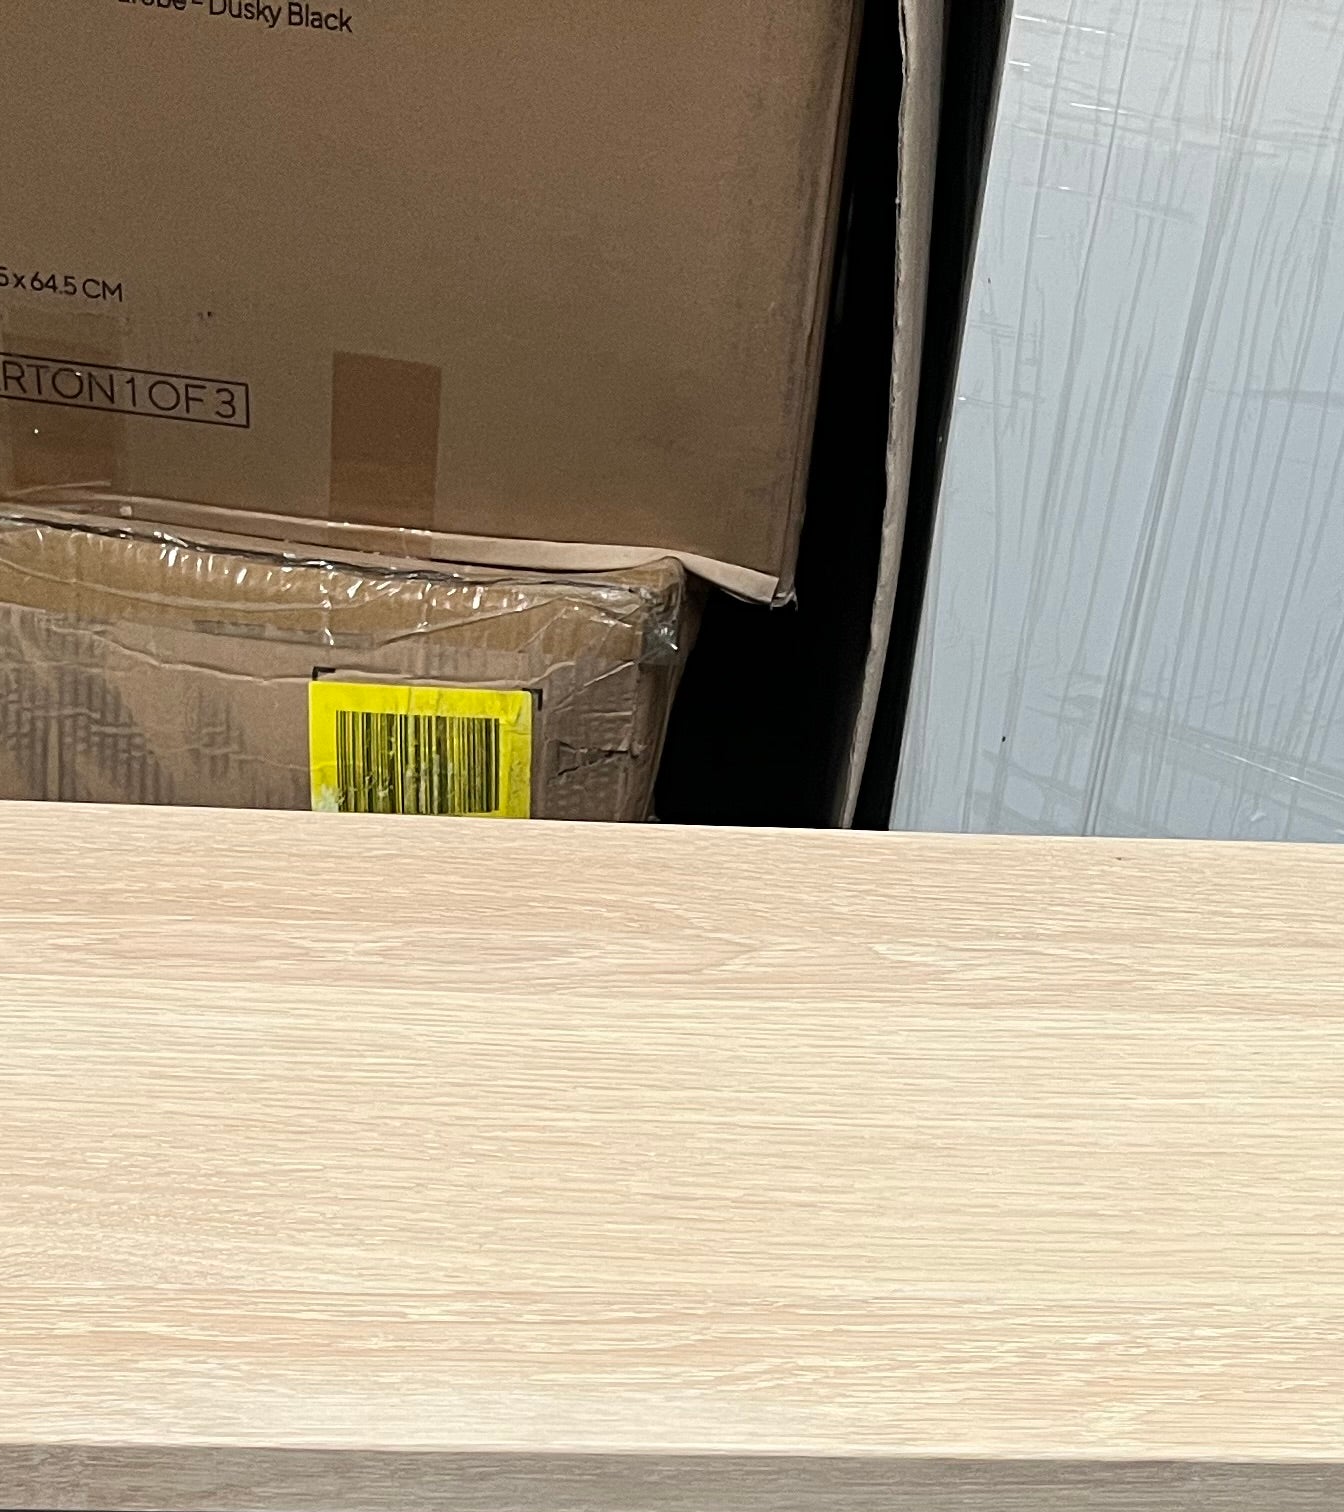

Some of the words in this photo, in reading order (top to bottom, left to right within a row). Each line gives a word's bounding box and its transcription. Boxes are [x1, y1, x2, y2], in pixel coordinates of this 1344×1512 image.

[208, 0, 282, 28] Dusky
[288, 2, 353, 33] Black
[82, 278, 124, 302] CM
[125, 377, 136, 407] 1
[148, 380, 207, 414] OF
[214, 388, 236, 419] 3
